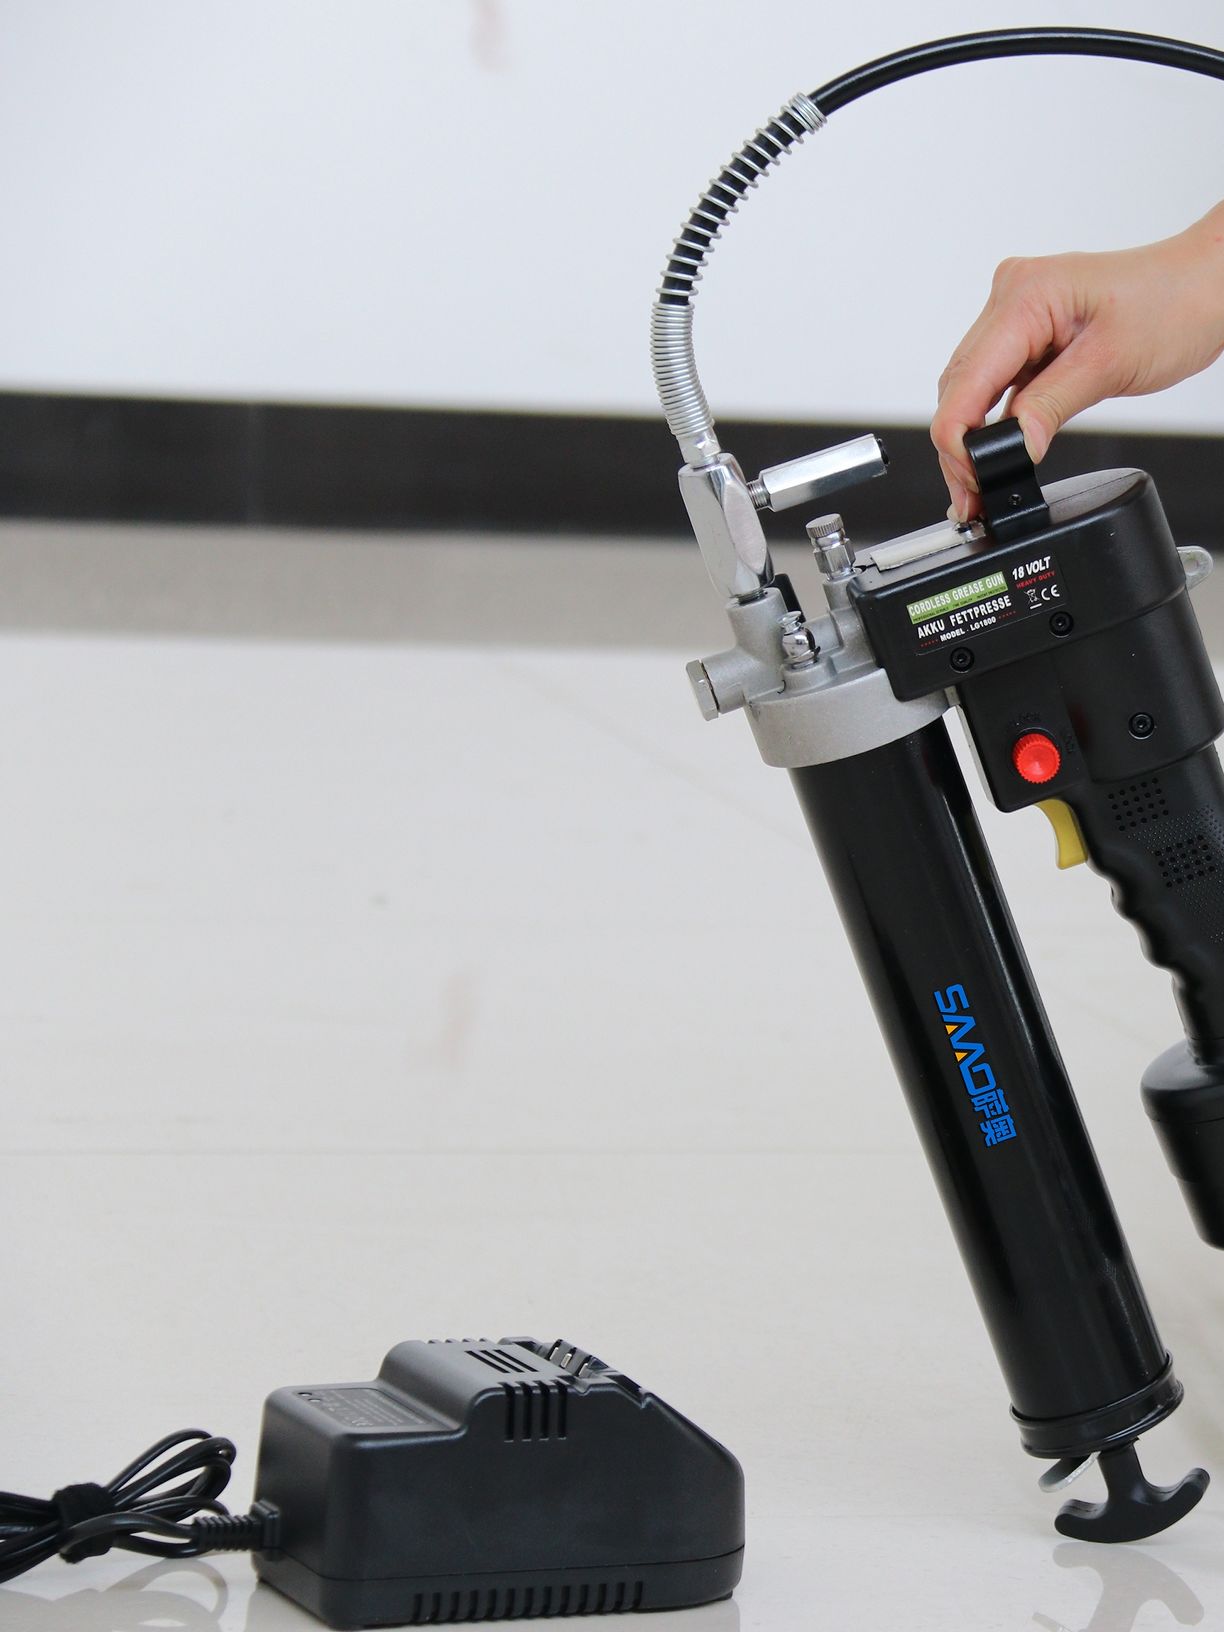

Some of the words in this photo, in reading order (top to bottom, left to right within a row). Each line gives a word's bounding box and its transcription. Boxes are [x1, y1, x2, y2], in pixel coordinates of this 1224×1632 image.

[1012, 566, 1025, 580] 18
[1025, 556, 1051, 576] VOLT
[1016, 578, 1037, 589] HEAVY
[1038, 571, 1056, 581] DUTY
[908, 593, 951, 617] CORDLESS
[952, 581, 985, 601] GREASE
[985, 574, 1005, 589] GUN
[917, 619, 945, 639] AKKU
[949, 595, 1012, 627] FETTPRESSE
[940, 628, 966, 642] MODEL
[969, 616, 997, 631] LG1800
